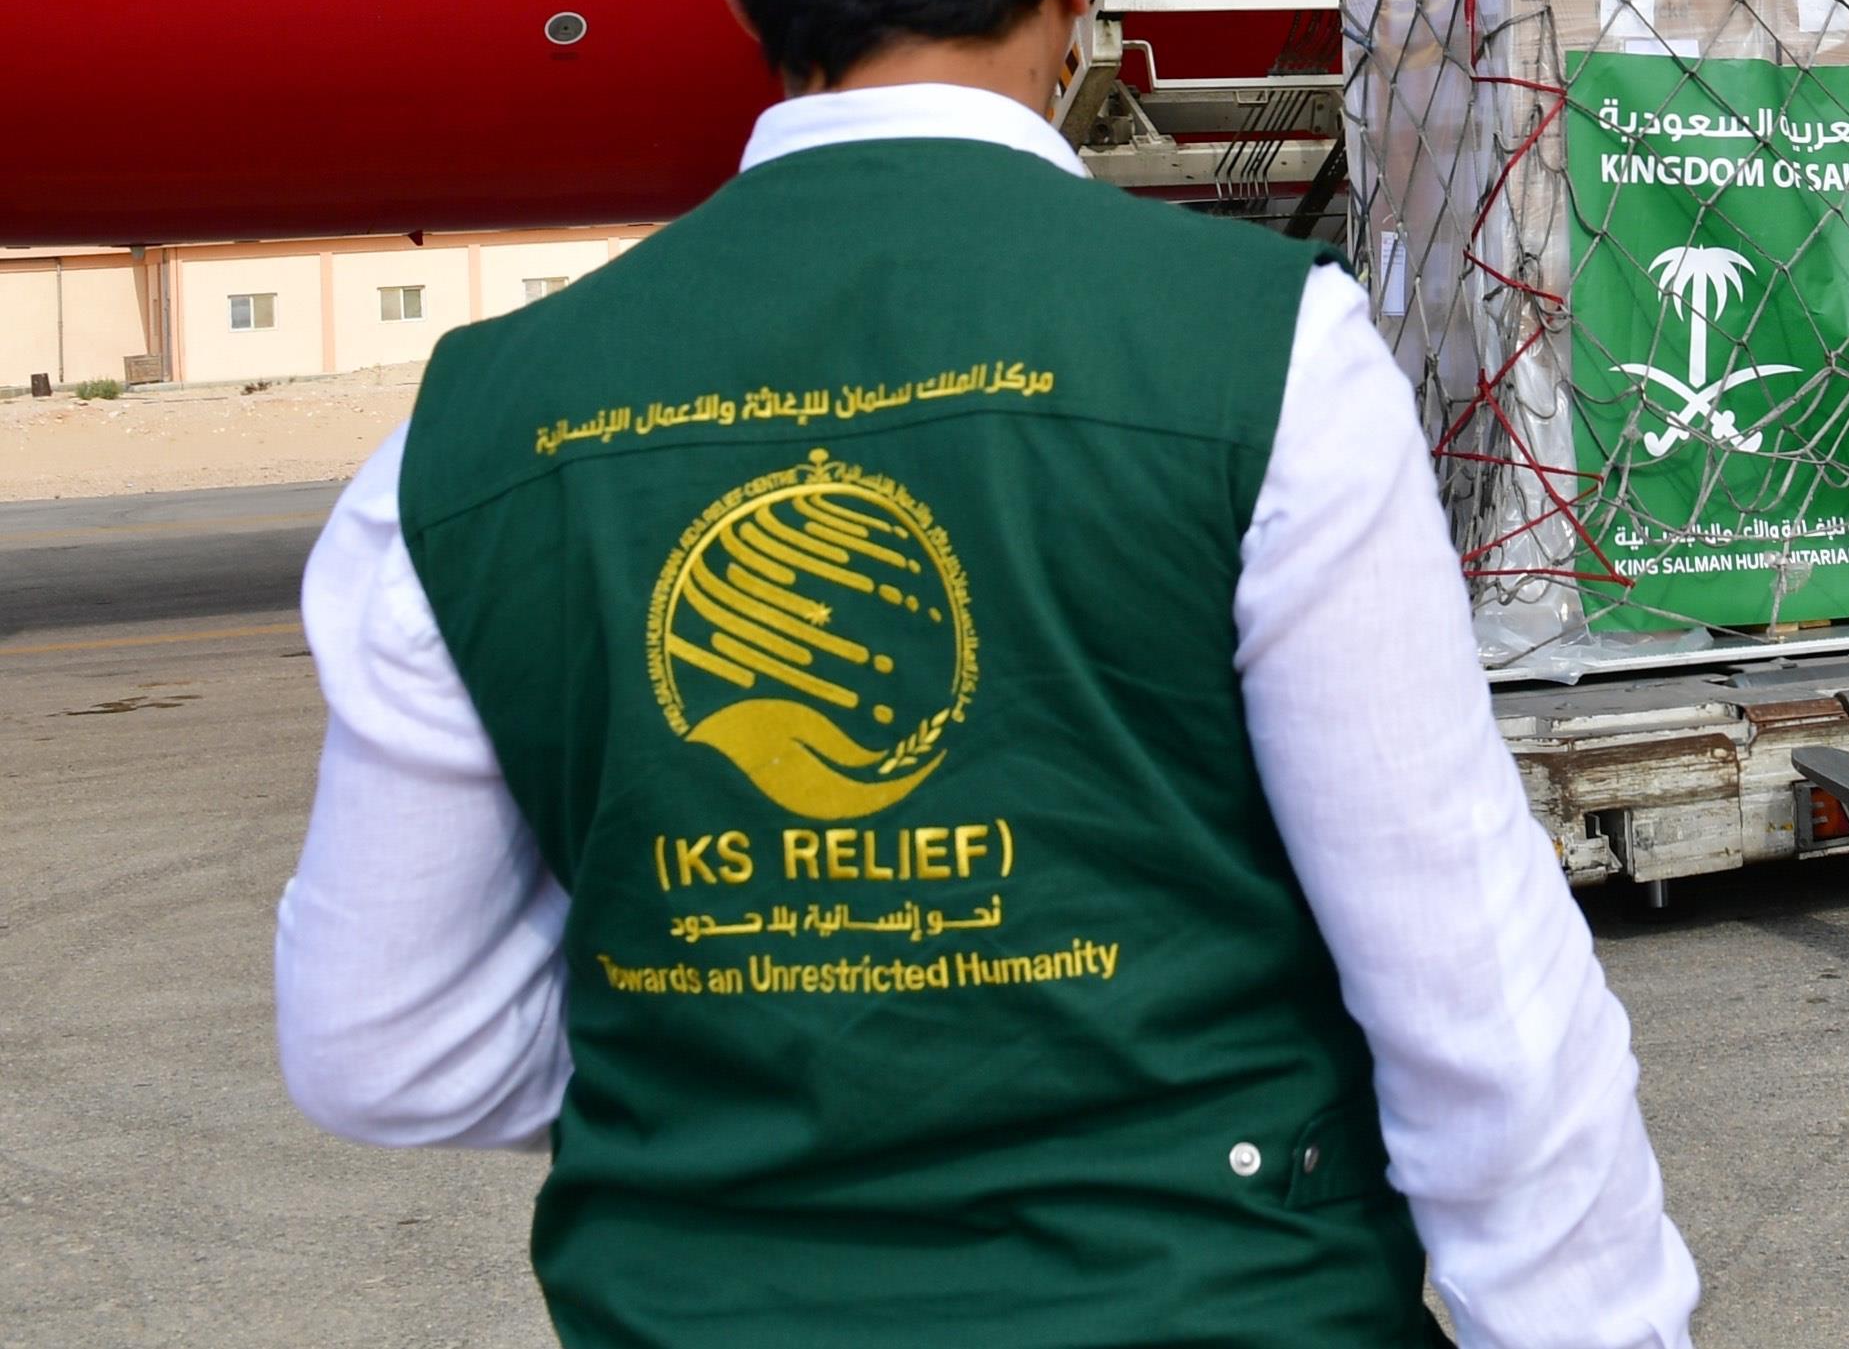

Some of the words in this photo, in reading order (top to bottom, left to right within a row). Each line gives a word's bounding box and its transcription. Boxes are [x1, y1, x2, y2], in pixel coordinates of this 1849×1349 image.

[1598, 98, 1773, 143] السعودية
[1601, 154, 1765, 188] KINGDOM
[916, 363, 988, 400] الملك
[984, 360, 1054, 396] مركز
[835, 383, 911, 419] سلمان
[1614, 557, 1659, 576] KING
[1662, 554, 1733, 574] SALMAN
[654, 829, 754, 892] (KS
[782, 818, 1014, 880] RELIEF)
[669, 911, 764, 943] حدود
[766, 905, 798, 938] بلا
[926, 894, 1001, 936] نحو
[707, 967, 744, 995] an
[749, 954, 950, 994] Unrestricted
[954, 937, 1119, 987] Humanity
